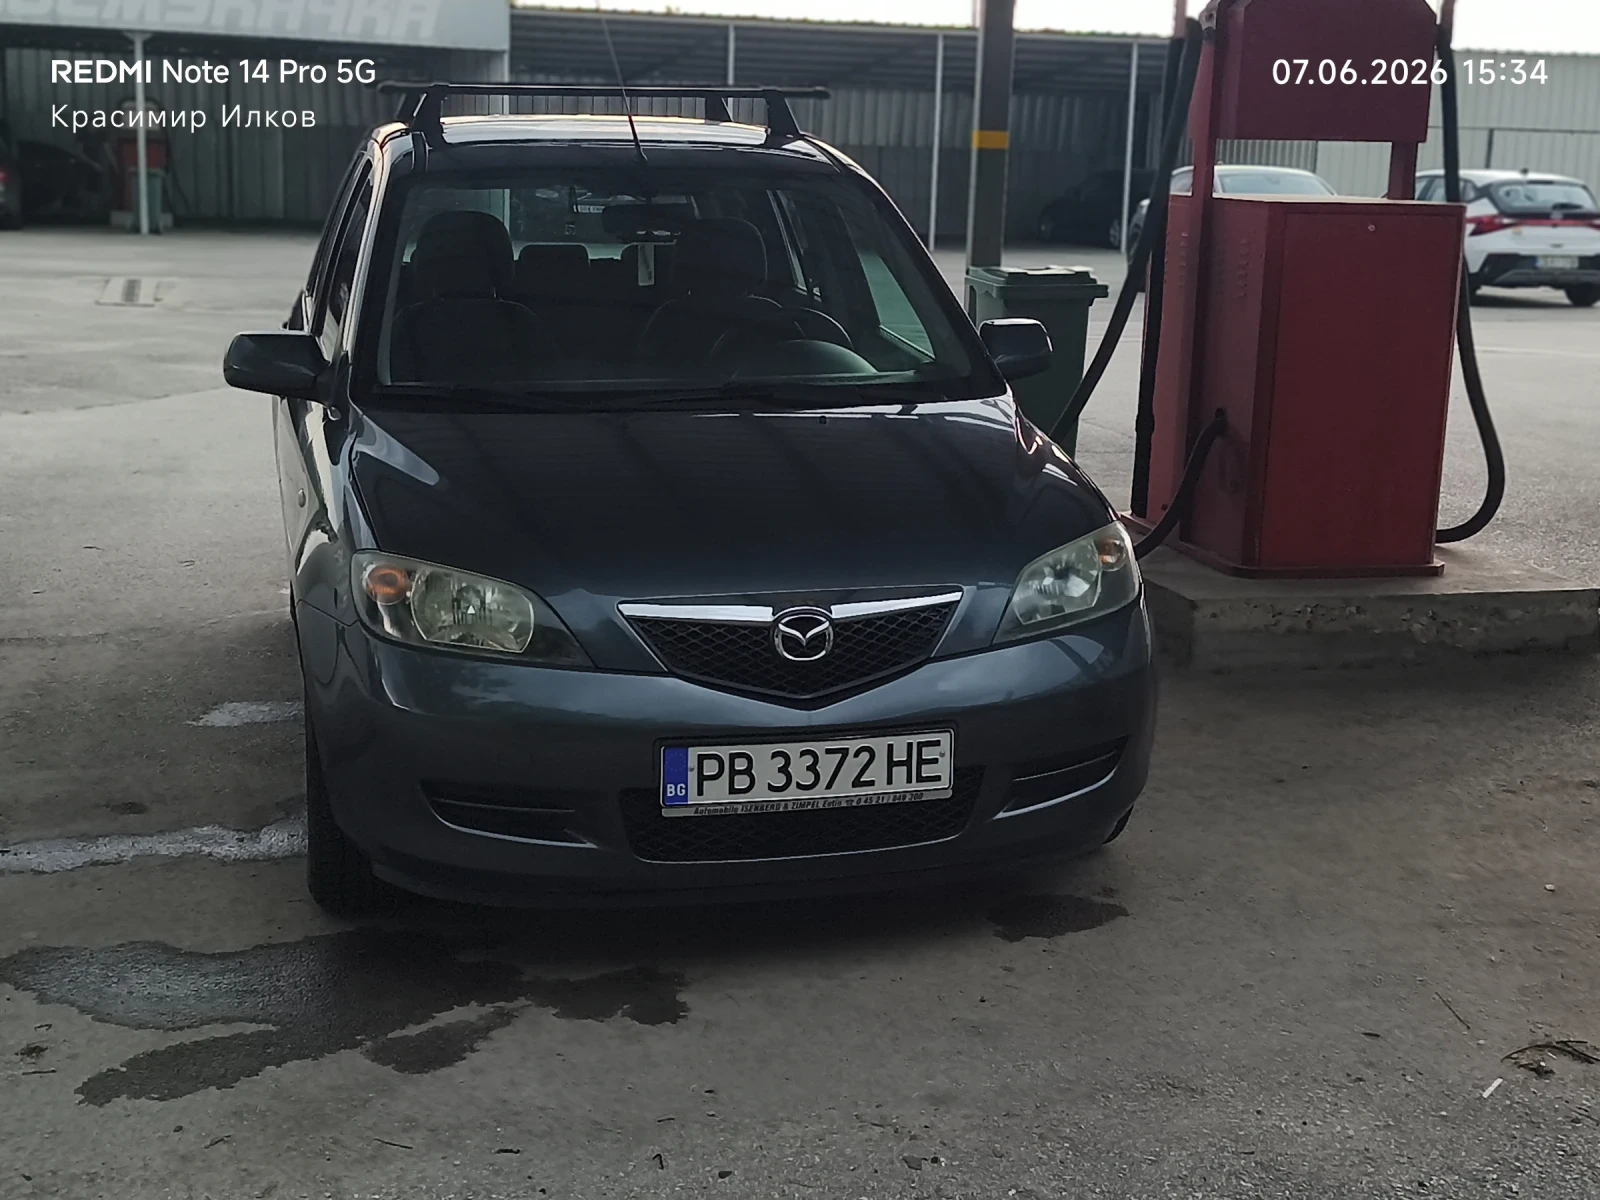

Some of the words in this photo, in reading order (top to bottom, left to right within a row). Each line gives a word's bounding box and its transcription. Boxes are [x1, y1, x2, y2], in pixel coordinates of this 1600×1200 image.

[696, 750, 756, 797] PB
[766, 744, 877, 793] 3372
[886, 738, 942, 785] HE
[666, 783, 686, 797] BG
